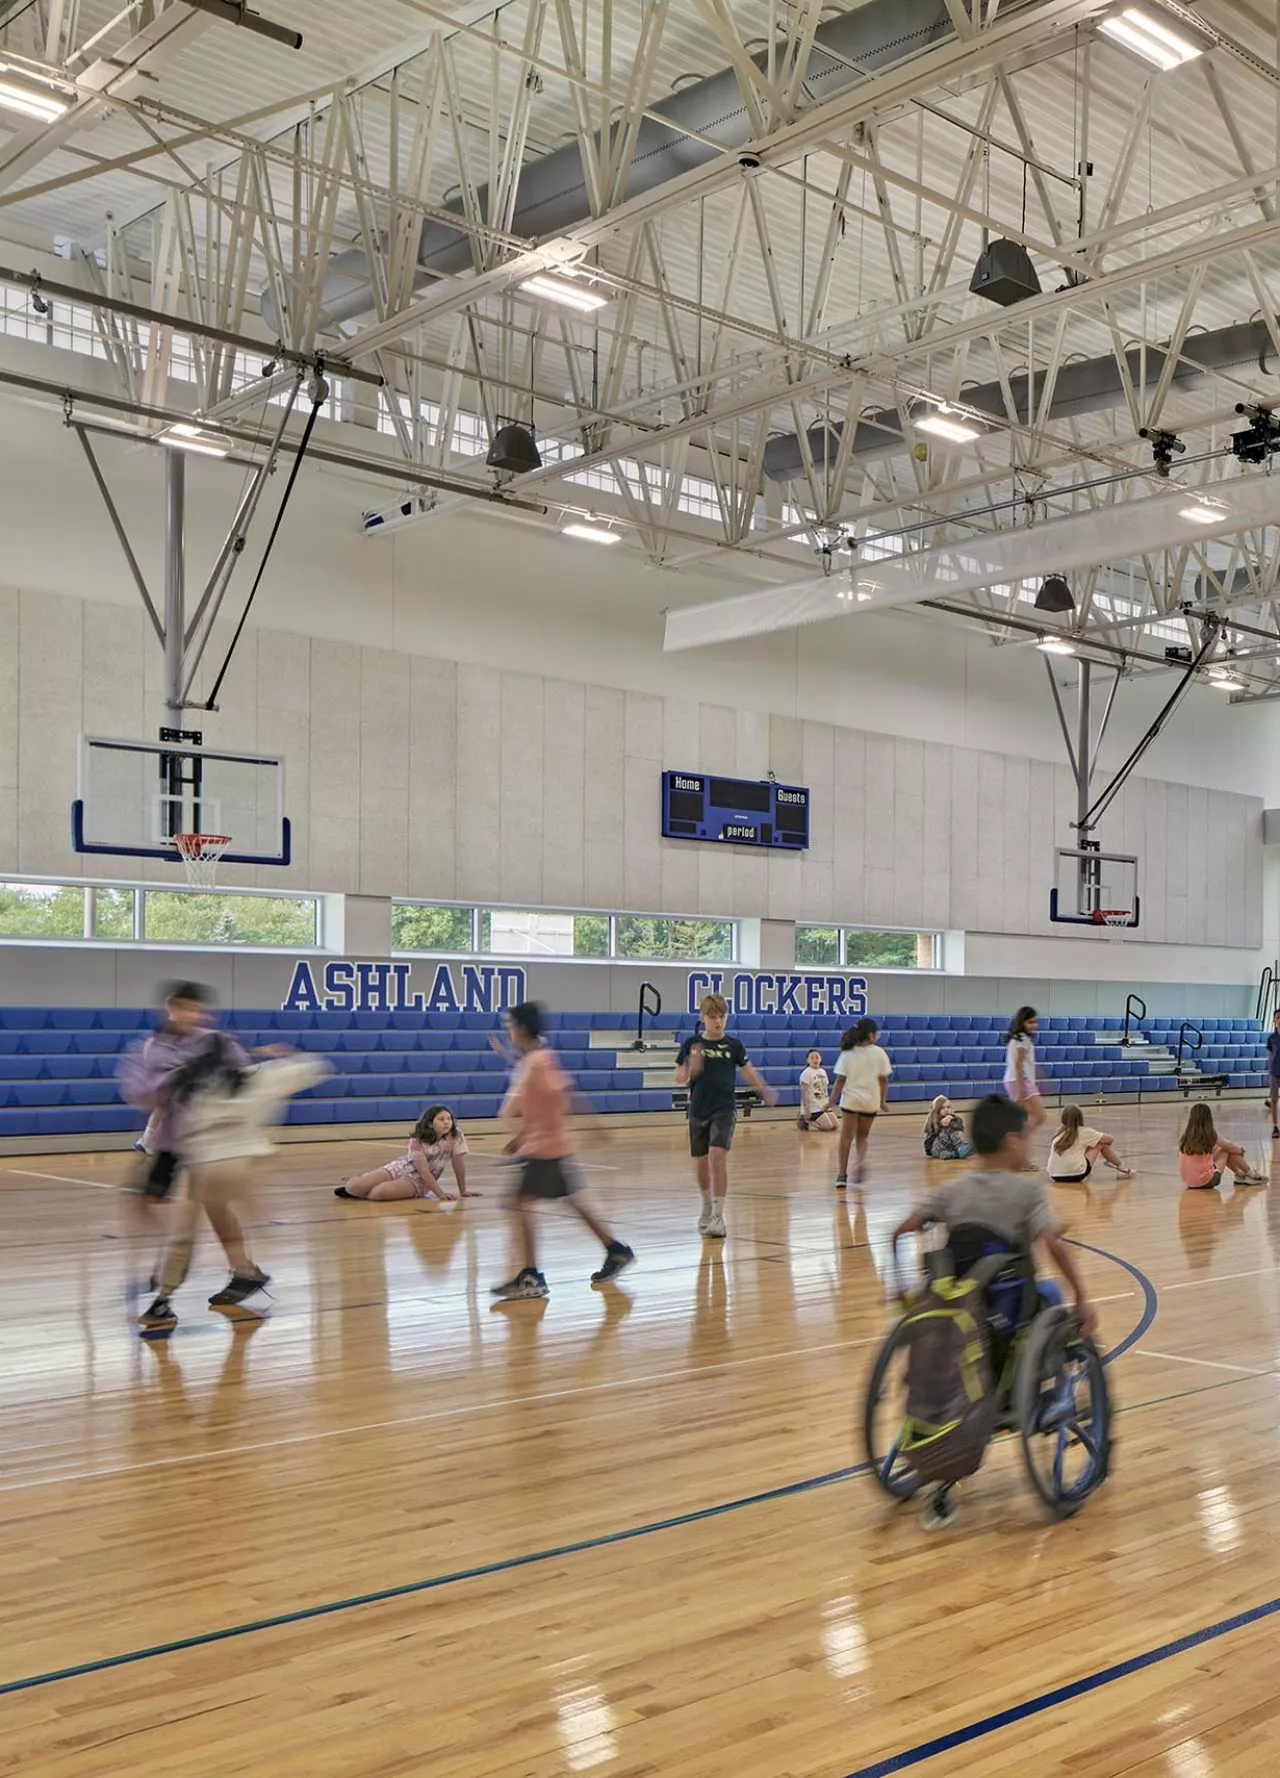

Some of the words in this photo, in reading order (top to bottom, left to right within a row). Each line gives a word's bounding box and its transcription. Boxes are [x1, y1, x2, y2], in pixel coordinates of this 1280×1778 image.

[675, 776, 701, 790] Home
[777, 789, 805, 804] Guests
[727, 826, 755, 838] period
[281, 960, 527, 1012] ASHLAND
[687, 971, 868, 1015] CLOCKERS
